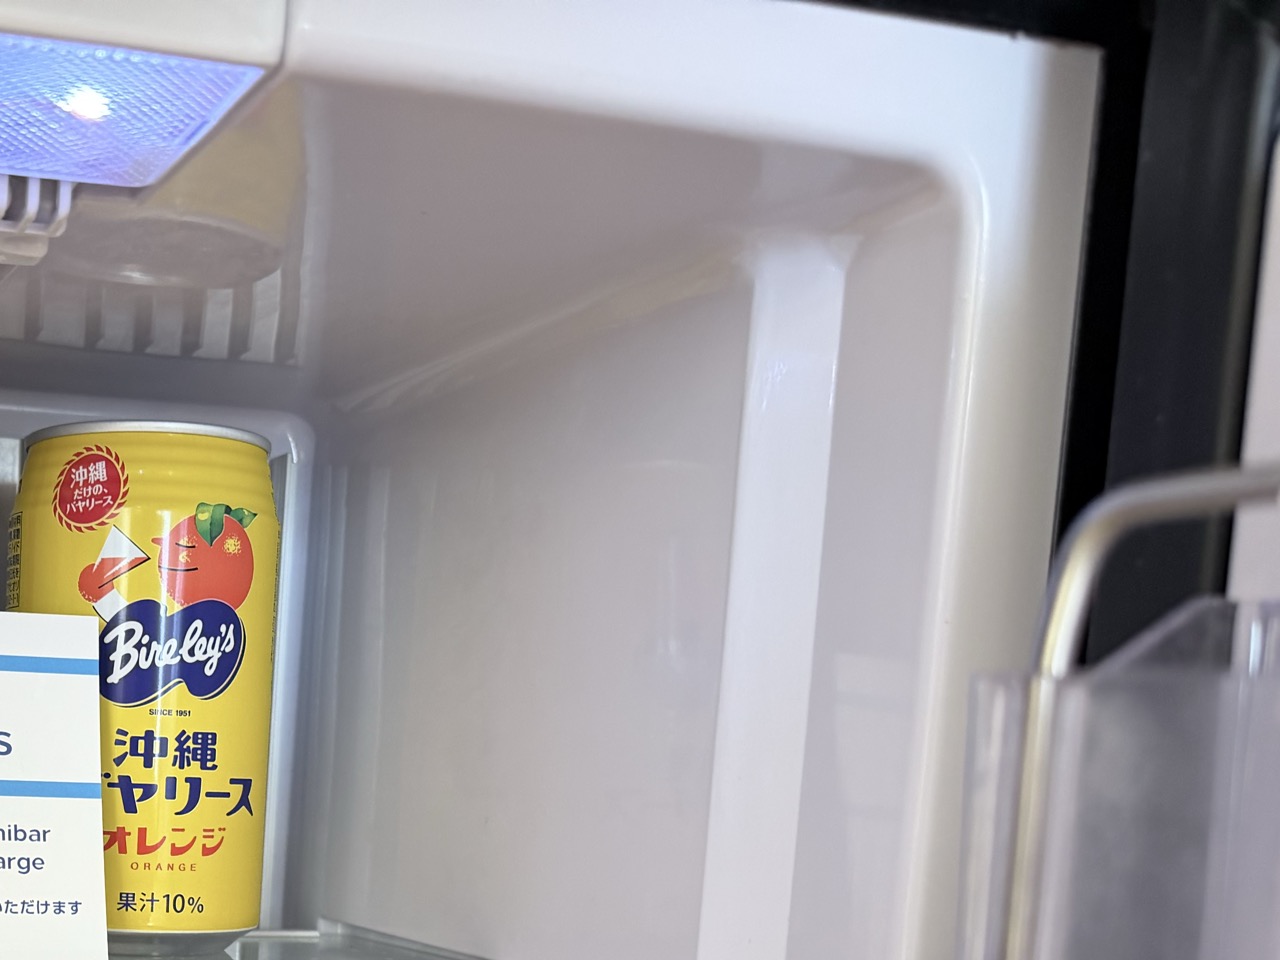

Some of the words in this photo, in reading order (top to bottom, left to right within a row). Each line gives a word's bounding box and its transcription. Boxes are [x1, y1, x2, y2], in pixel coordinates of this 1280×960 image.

[70, 459, 108, 488] 沖縄
[65, 494, 114, 515] バヤリース
[103, 618, 235, 684] Bireley's
[149, 708, 173, 717] SINCE
[175, 709, 191, 717] 1951
[112, 728, 219, 771] 沖縄
[101, 772, 254, 817] ヤリース
[103, 826, 227, 857] オレンジ
[130, 862, 197, 872] ORANGE
[116, 891, 205, 914] 果汁10%
